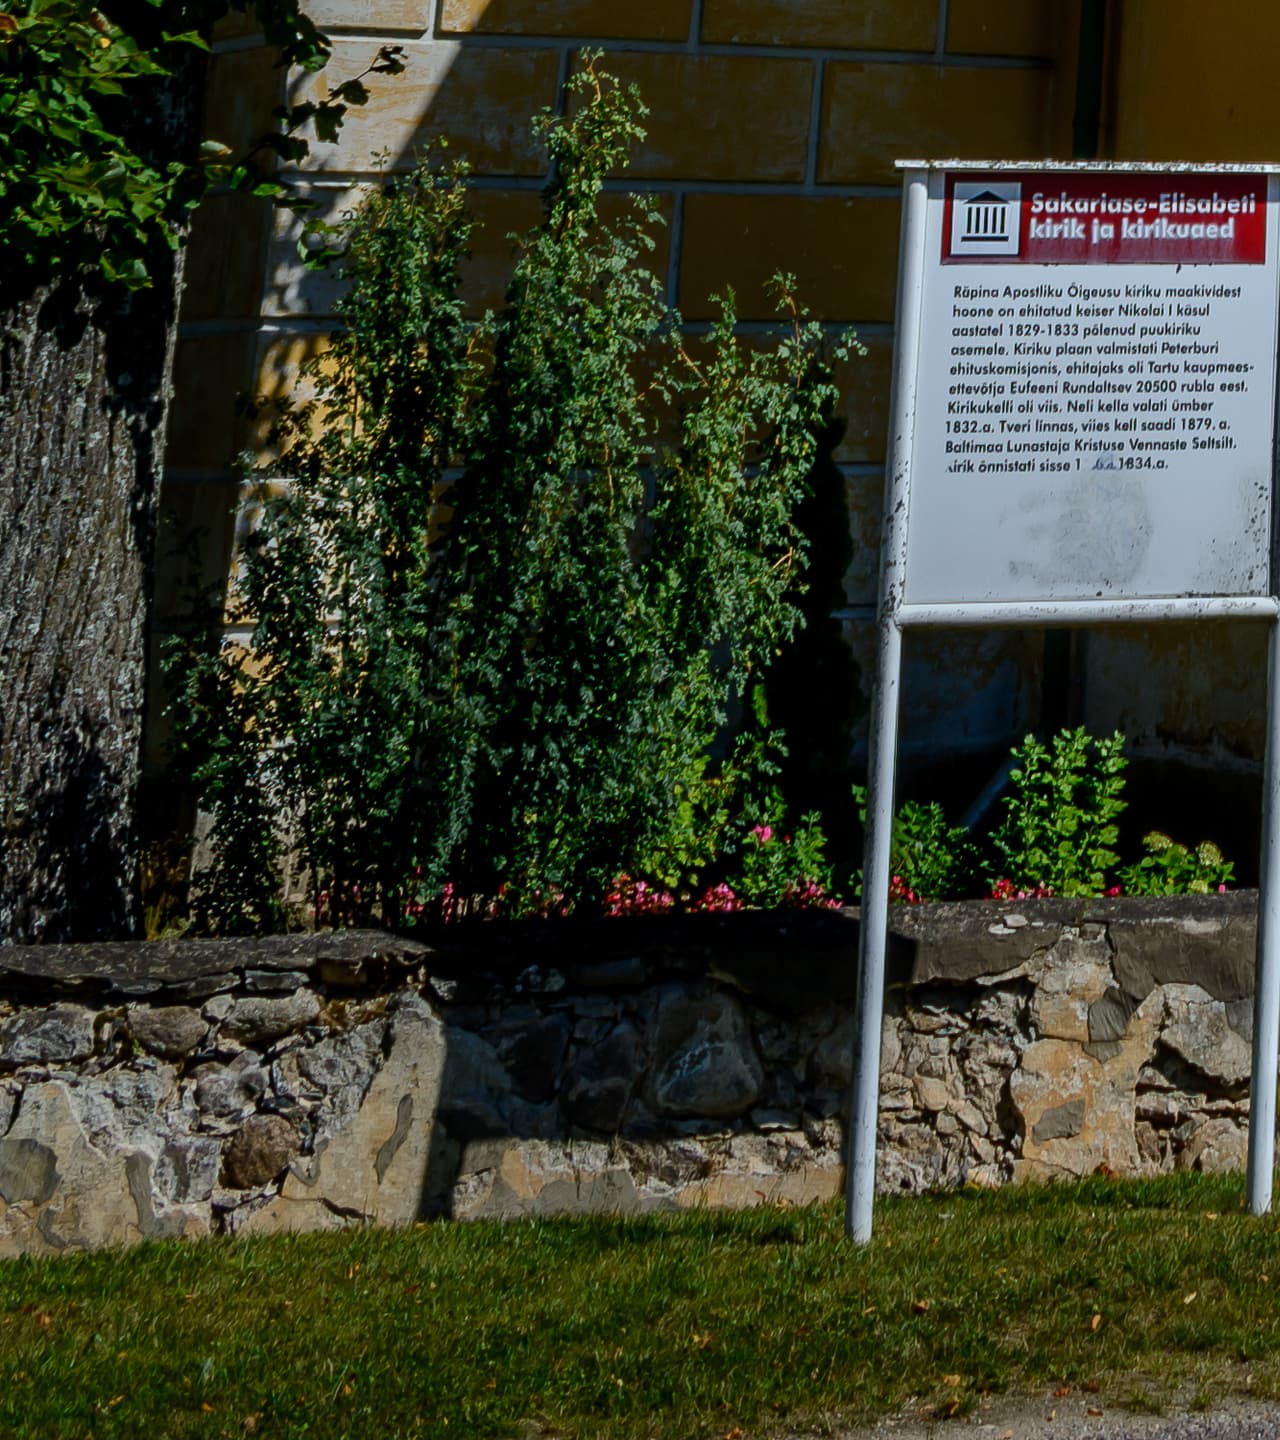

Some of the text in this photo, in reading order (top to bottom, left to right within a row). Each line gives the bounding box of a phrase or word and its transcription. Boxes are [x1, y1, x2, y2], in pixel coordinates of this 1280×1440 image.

[1030, 192, 1256, 214] Sakariase-Elisabeti
[1030, 217, 1235, 244] kirik ja kirikuaed
[954, 282, 1241, 300] Räpina Apostliku Õigeusu kiriku maakividest
[953, 303, 1210, 317] hoone on ehitatud keiser Nikolai I käsul
[952, 322, 1200, 339] aastatel 1829-1833 põlenud puukiriku
[951, 341, 1218, 357] asemele. Kiriku plaan valmistati Peterburi
[950, 360, 1254, 377] ehituskomisjonis, ehitajaks oli Tartu kaupmees-
[949, 381, 1004, 397] ettevõtja
[1010, 380, 1058, 394] Eufeeni
[1136, 380, 1177, 393] 20500
[1182, 379, 1214, 392] rubla
[1220, 380, 1248, 392] eest.
[948, 398, 1214, 414] Kirikukelli oli viis. Neli kella valati ümber
[1000, 419, 1031, 432] Tveri
[1036, 419, 1078, 434] linnas,
[1082, 419, 1110, 432] viies
[1114, 418, 1137, 432] kell
[1141, 418, 1176, 430] saadi
[946, 436, 1237, 455] Baltimaa Lunastaja Kristuse Vennaste Seltsilt.
[978, 459, 1036, 472] õnnistati
[1040, 459, 1070, 472] sisse
